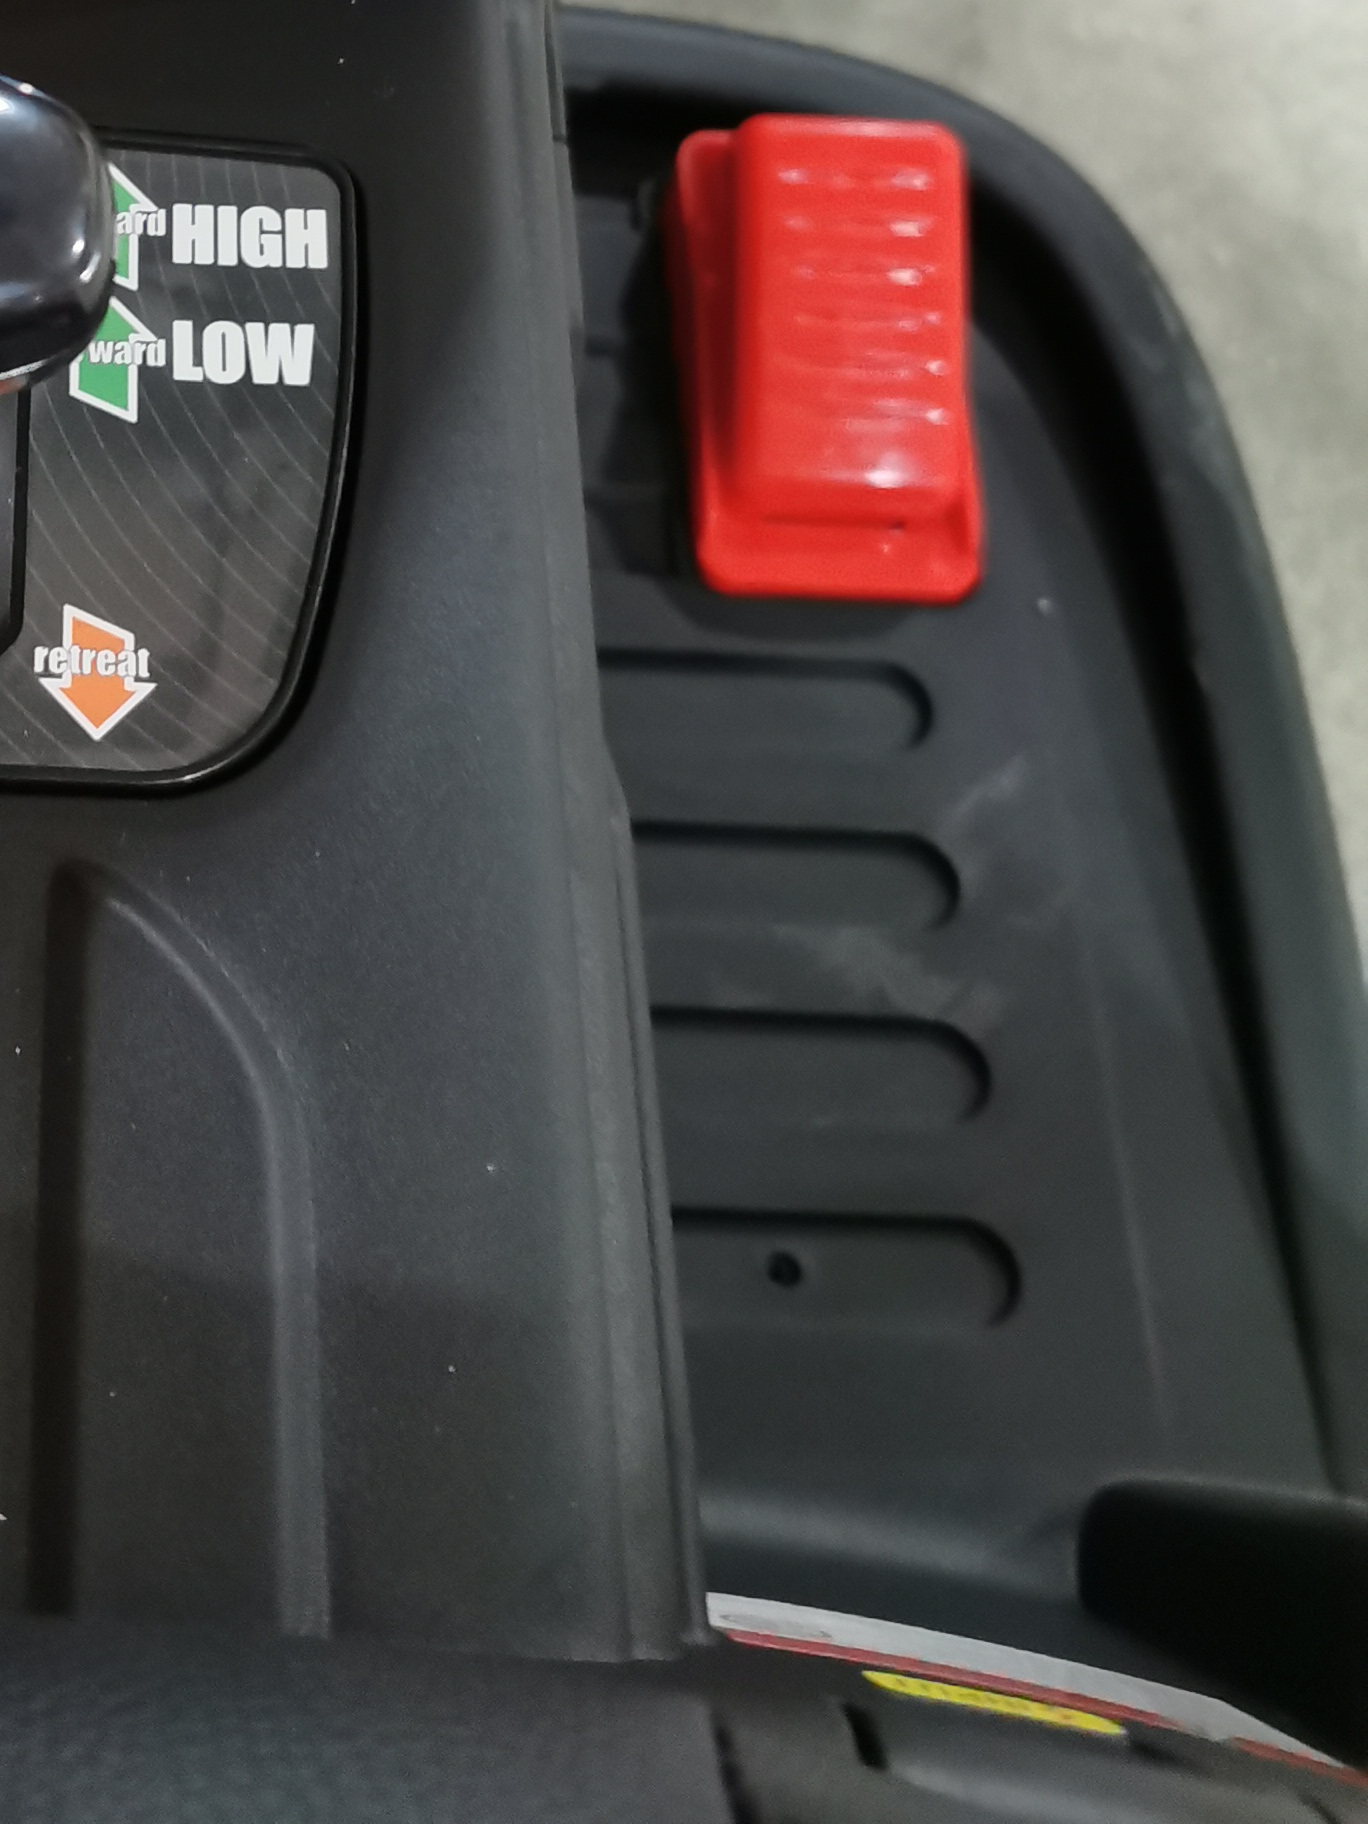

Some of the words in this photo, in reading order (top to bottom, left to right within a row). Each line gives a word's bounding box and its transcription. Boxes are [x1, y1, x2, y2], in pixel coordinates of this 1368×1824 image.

[172, 203, 328, 269] HIGH
[88, 338, 166, 367] ward
[172, 319, 315, 386] LOW
[34, 644, 150, 678] retreat
